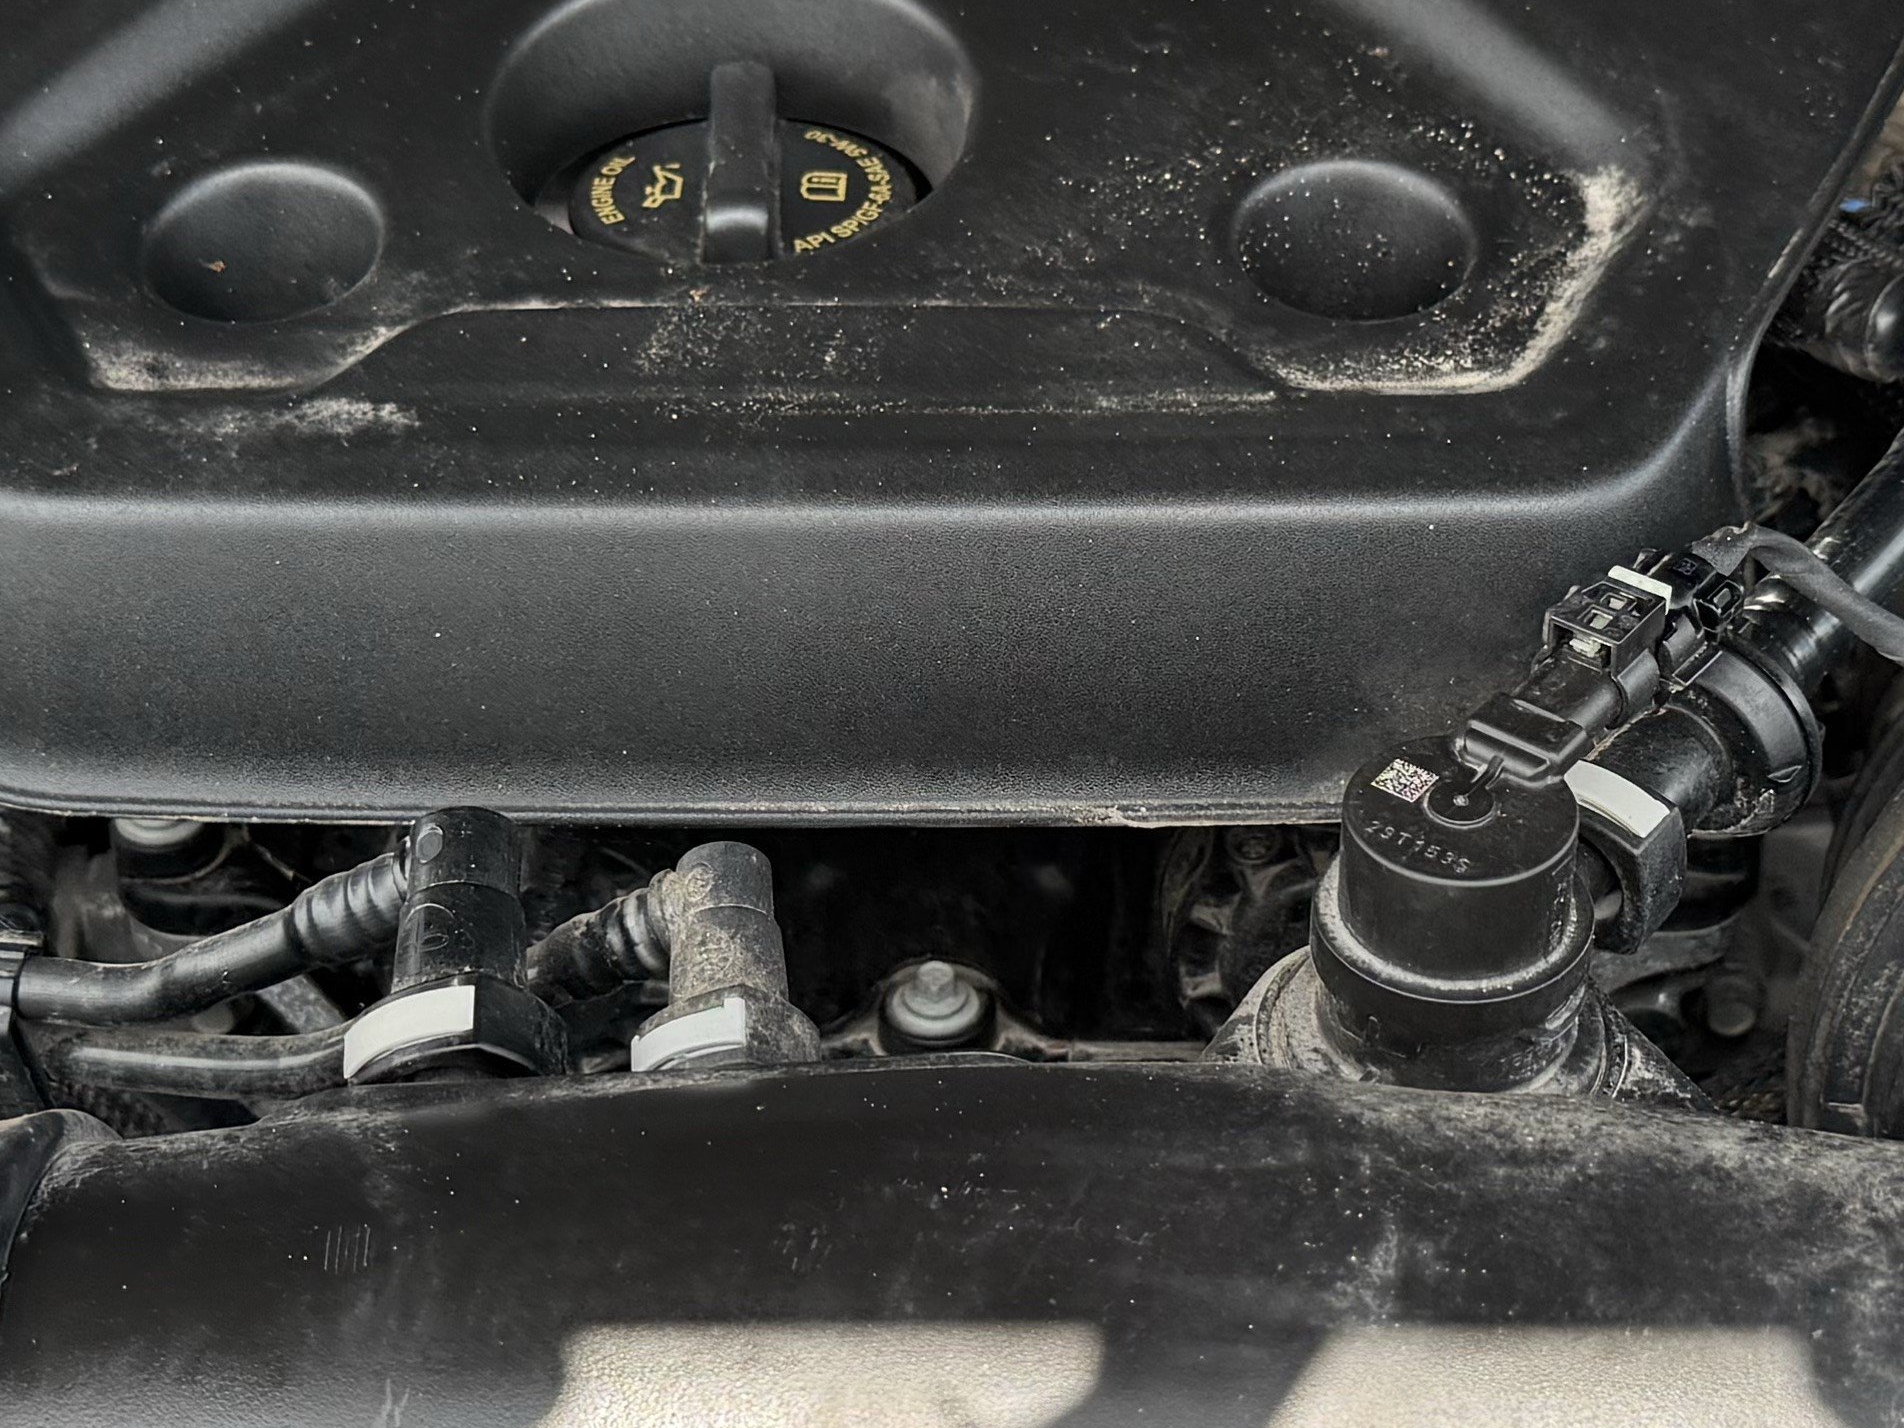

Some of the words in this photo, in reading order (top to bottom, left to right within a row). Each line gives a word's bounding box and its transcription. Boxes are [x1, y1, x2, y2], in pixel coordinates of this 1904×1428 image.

[803, 129, 869, 158] 5W-30
[600, 156, 636, 176] OIL
[590, 176, 626, 225] ENGINE
[793, 230, 837, 254] API
